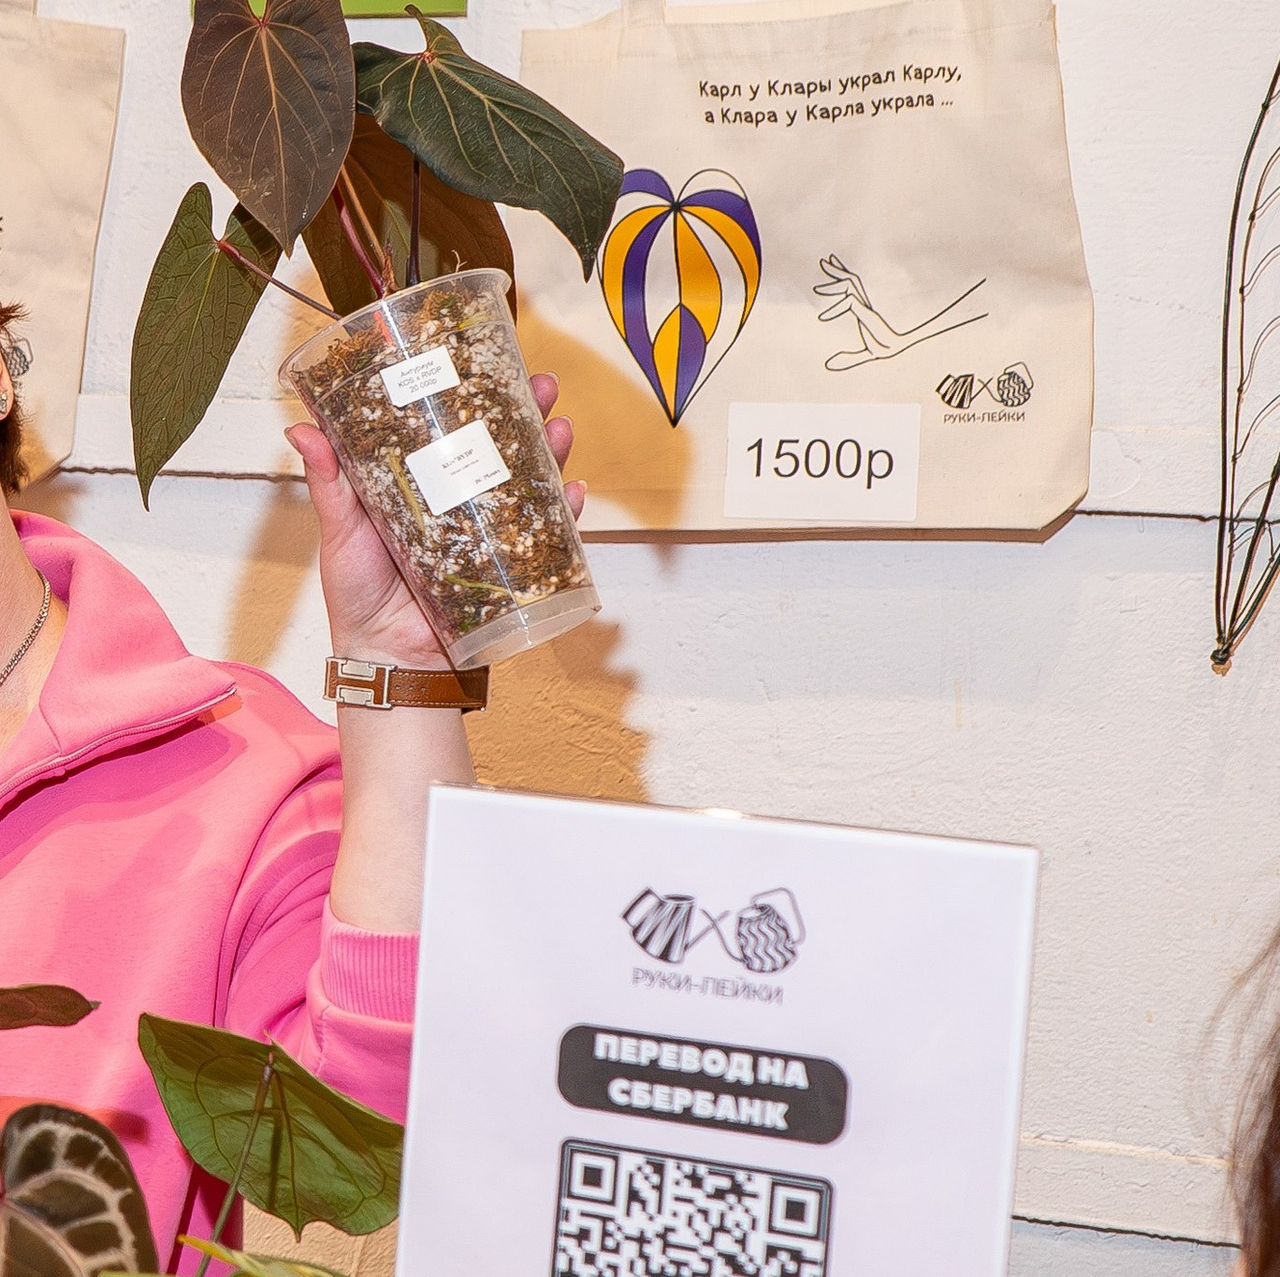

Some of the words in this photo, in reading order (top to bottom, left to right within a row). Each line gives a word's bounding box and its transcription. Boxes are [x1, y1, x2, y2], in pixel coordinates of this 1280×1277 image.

[699, 80, 742, 102] Карл
[748, 84, 760, 102] у
[767, 79, 832, 99] Клары
[838, 70, 896, 96] украл
[903, 64, 962, 85] Карлу,
[704, 110, 715, 125] а
[720, 107, 779, 129] Клара
[785, 109, 798, 128] у
[806, 102, 866, 124] Карла
[870, 93, 935, 117] украла
[943, 409, 1026, 424] РУКИ-ЛЕЙКИ
[747, 437, 894, 490] 1500р
[631, 967, 784, 1006] РУКИ-ЛЕЙКИ
[593, 1033, 755, 1086] ПЕРЕВОД
[757, 1055, 810, 1090] НА
[607, 1078, 790, 1132] СБЕРБАНК
